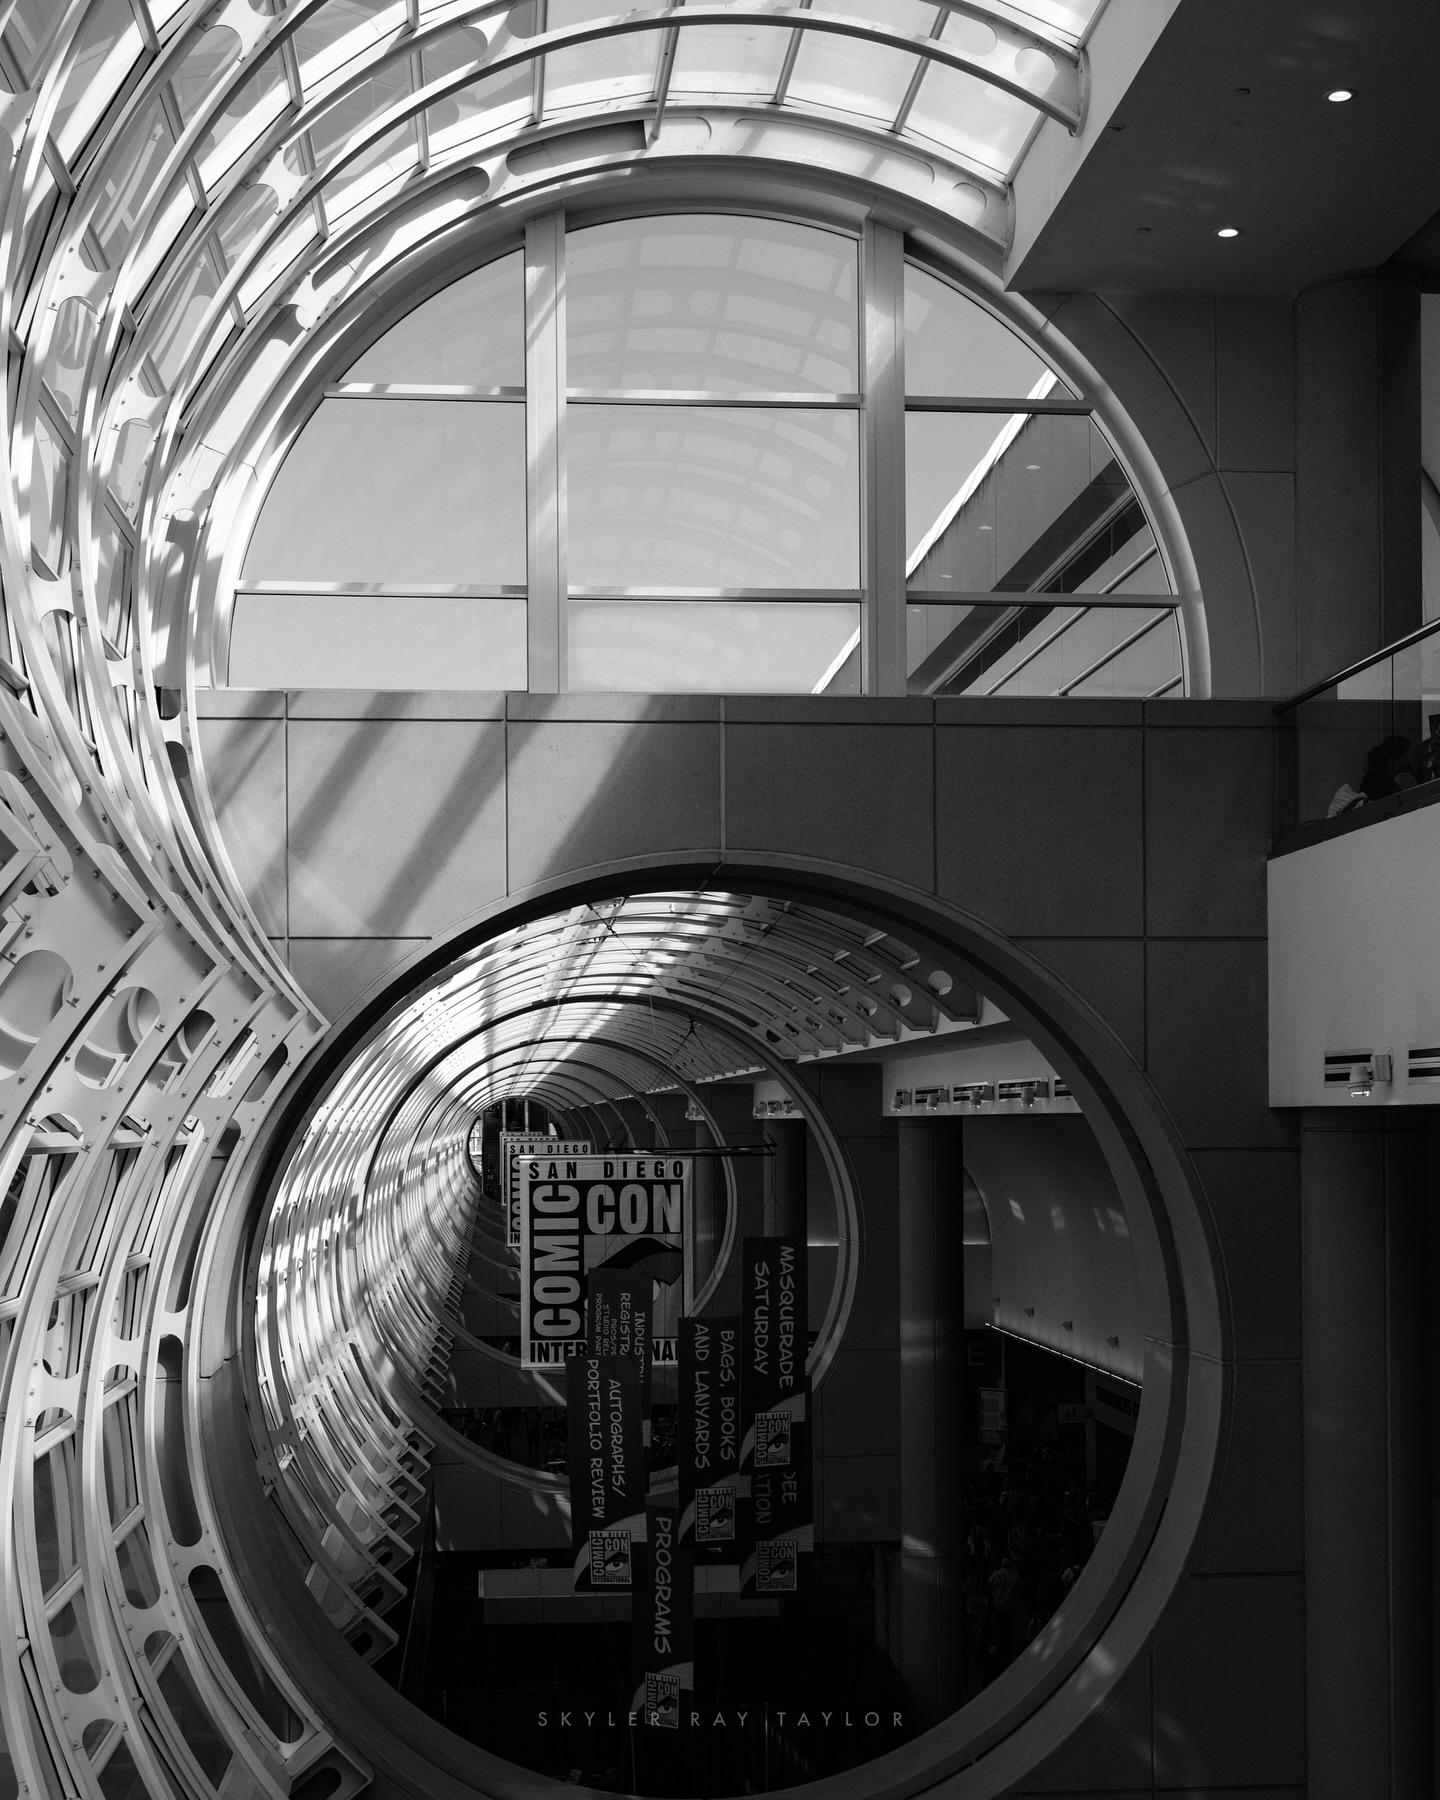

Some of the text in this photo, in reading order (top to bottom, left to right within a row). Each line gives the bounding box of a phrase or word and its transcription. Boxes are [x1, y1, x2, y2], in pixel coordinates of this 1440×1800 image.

[510, 1144, 588, 1154] SAN DIEGO
[529, 1160, 684, 1180] SAN DIEGO
[586, 1183, 682, 1235] CON
[532, 1183, 582, 1338] COMIC
[619, 1292, 631, 1357] REGISTR
[754, 1260, 770, 1375] SATURDAY
[778, 1245, 795, 1390] MASQUERADE
[694, 1323, 711, 1470] AND LANYARDS
[720, 1330, 736, 1461] BAGS, BOOKS
[587, 1359, 605, 1519] PORTFOLIO REVIEW
[608, 1379, 626, 1497] AUTOGRAPHS/
[757, 1419, 768, 1459] COMIC
[768, 1418, 789, 1432] CON
[697, 1495, 709, 1534] COMIC
[709, 1494, 733, 1508] CON
[591, 1537, 605, 1577] COMIC
[604, 1537, 628, 1551] CON
[770, 1546, 794, 1559] CON
[654, 1515, 672, 1655] PROGRAMS
[758, 1547, 771, 1583] COMIC
[657, 1681, 677, 1696] CON
